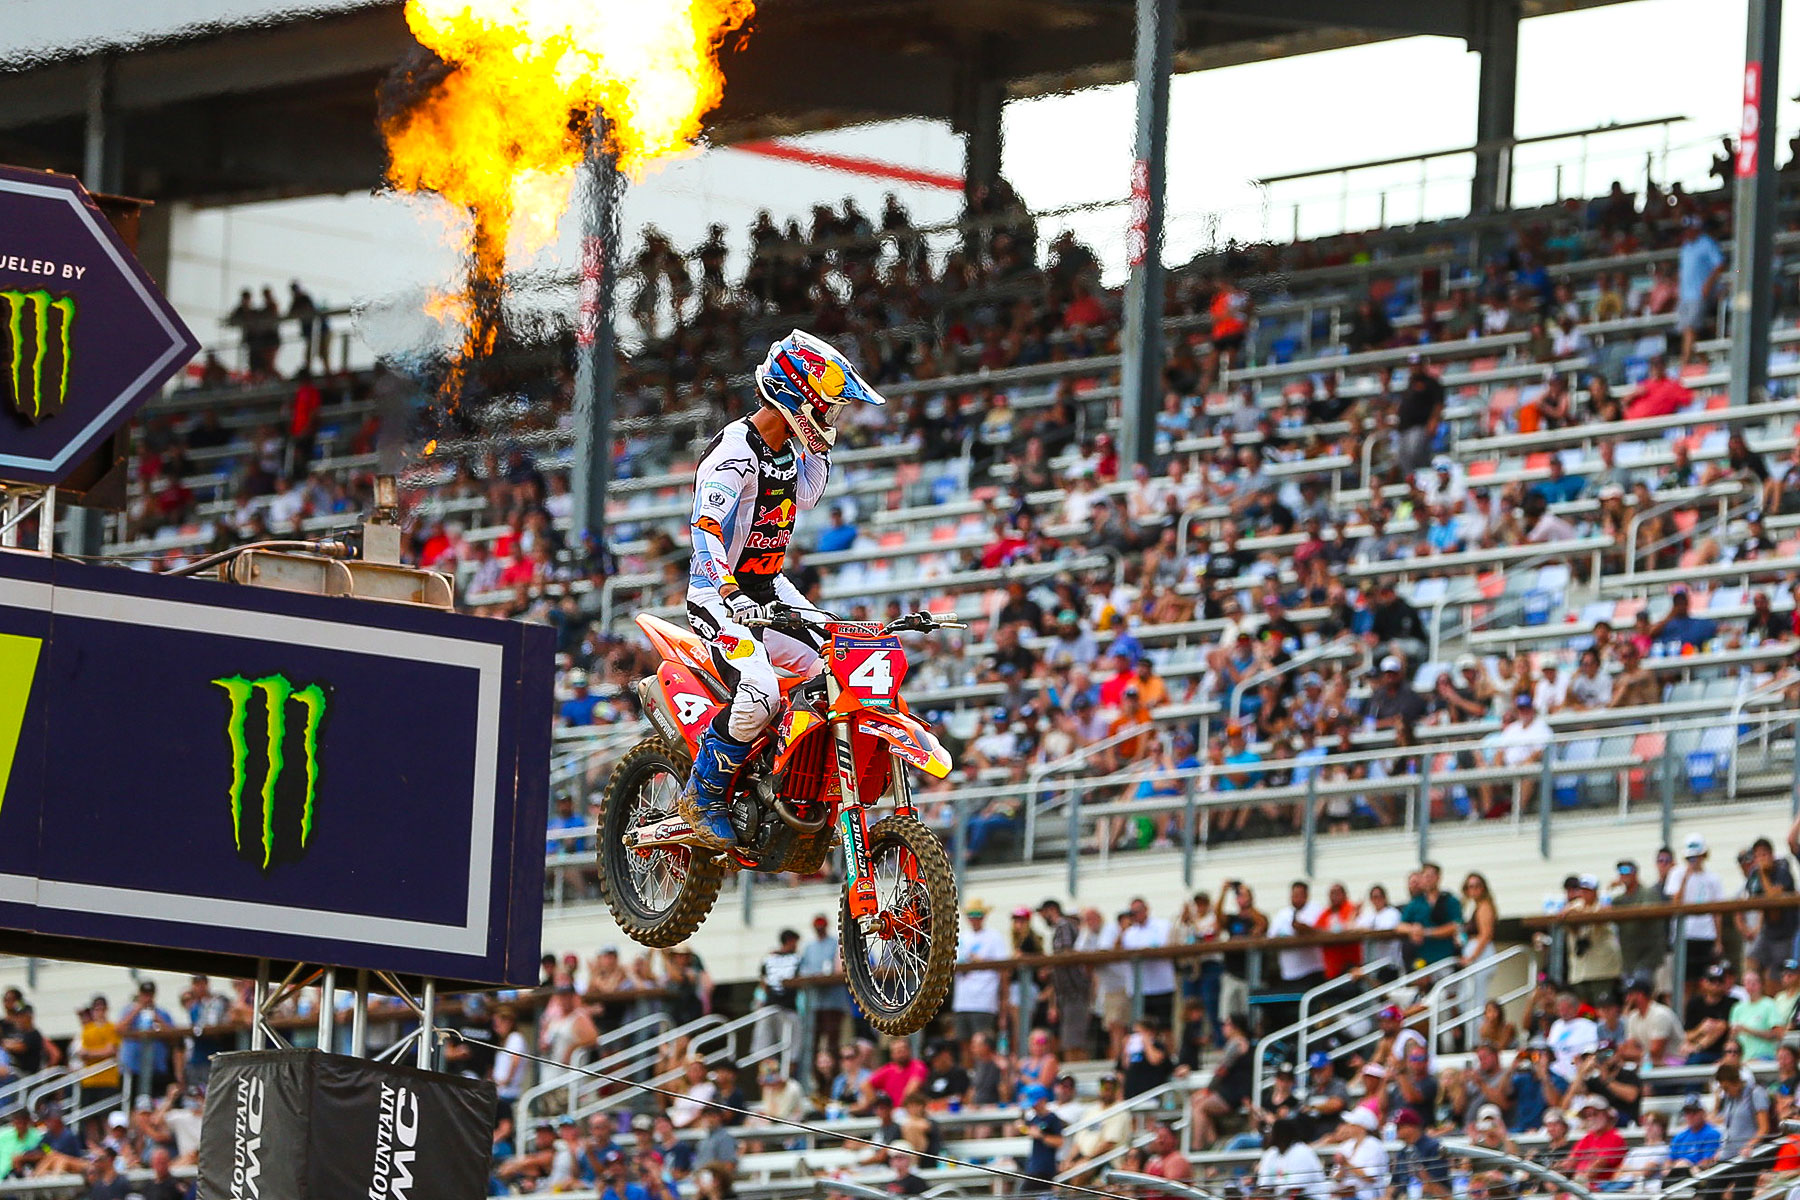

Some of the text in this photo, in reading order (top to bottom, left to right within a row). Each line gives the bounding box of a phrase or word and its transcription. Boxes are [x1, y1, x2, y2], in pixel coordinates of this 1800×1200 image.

[62, 264, 86, 280] BY
[790, 372, 824, 408] OAKLEY
[848, 650, 894, 695] 4
[672, 692, 716, 726] 4
[843, 833, 856, 879] MOTOREX
[852, 823, 868, 879] DUNLOP
